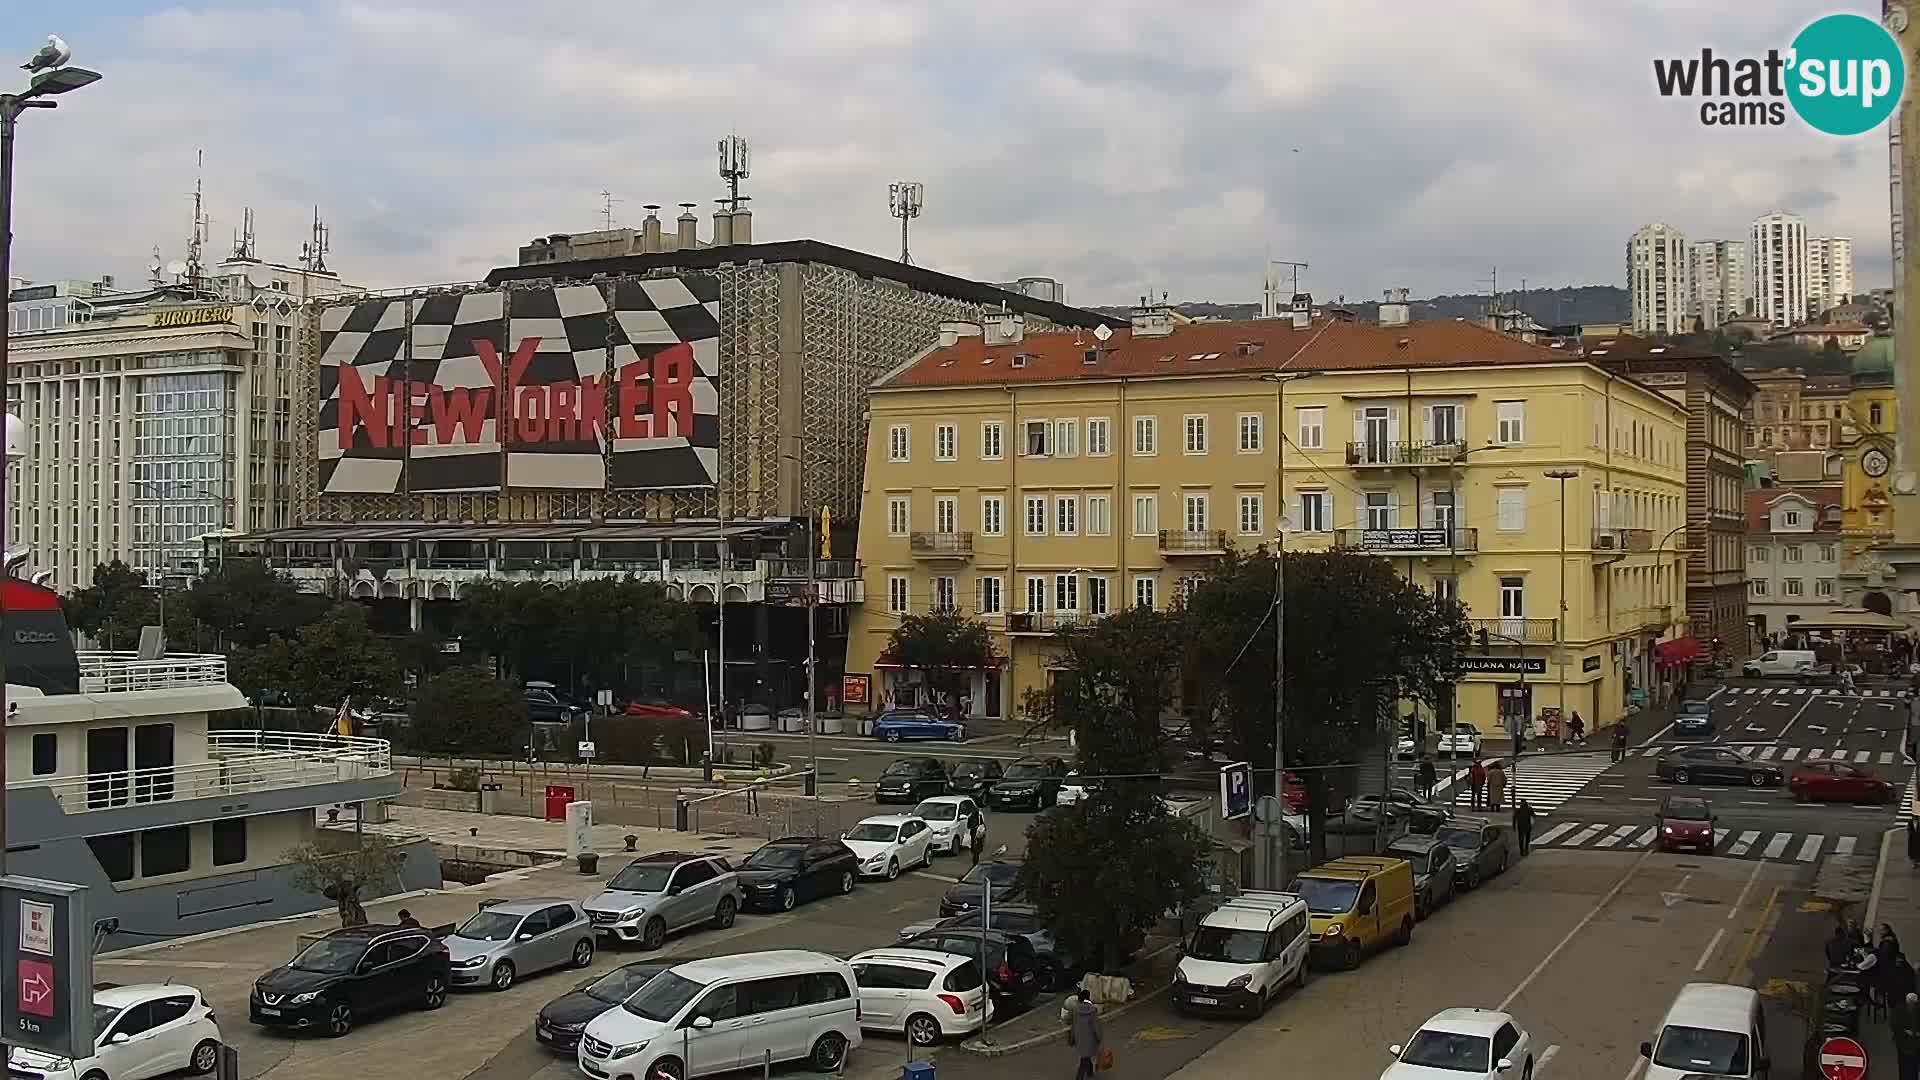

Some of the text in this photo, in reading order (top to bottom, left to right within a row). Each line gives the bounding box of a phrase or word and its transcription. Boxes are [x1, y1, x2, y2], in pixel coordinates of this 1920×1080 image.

[1459, 661, 1541, 670] JULIANA NAILS
[1232, 771, 1244, 794] P
[19, 1018, 41, 1033] 5 km
